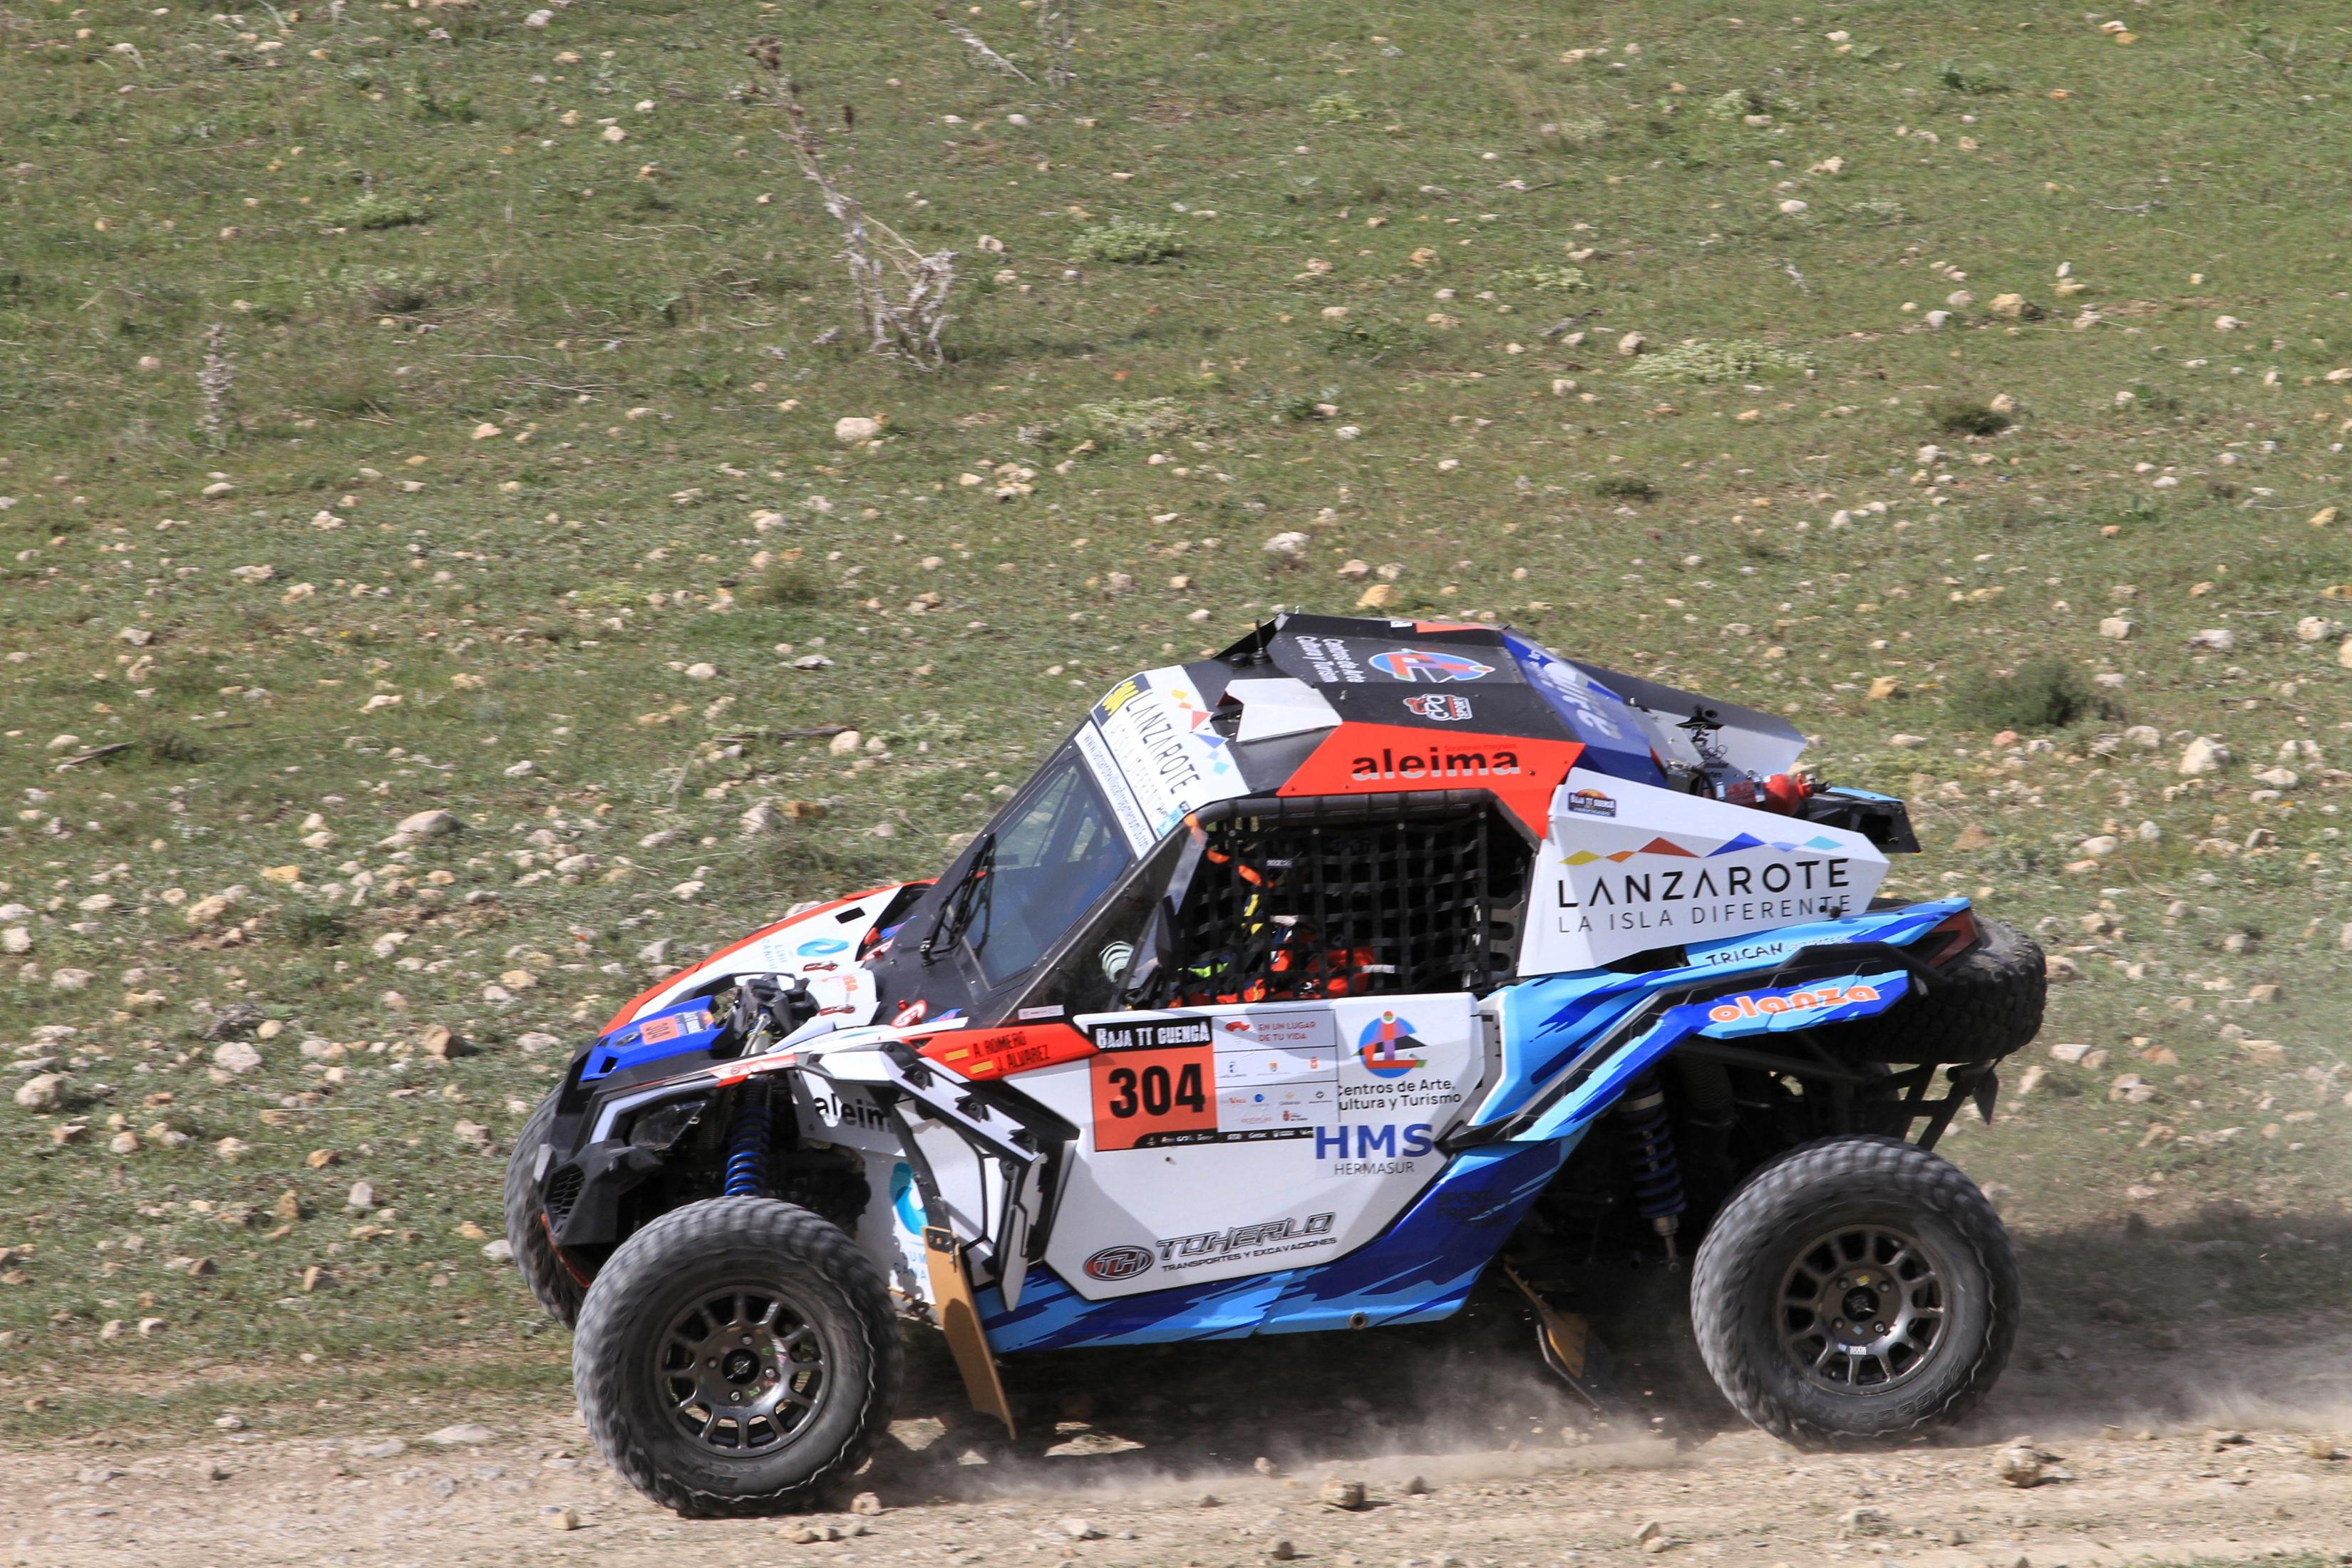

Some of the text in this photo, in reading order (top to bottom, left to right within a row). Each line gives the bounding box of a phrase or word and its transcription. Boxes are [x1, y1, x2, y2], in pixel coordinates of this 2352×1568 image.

[1322, 639, 1351, 661] Centros
[1336, 660, 1359, 669] de
[1125, 691, 1201, 795] LANZAROTE
[1352, 747, 1521, 780] aleima
[1558, 857, 1850, 909] LANZAROTE
[1559, 894, 1852, 933] LA ISLA DIFERENTE
[1706, 942, 1783, 966] TRICAN
[1708, 985, 1880, 1022] olanza
[1095, 1028, 1133, 1048] BAJA
[1136, 1027, 1154, 1046] TT
[1259, 1033, 1270, 1042] DE
[1272, 1022, 1284, 1031] UN
[1286, 1021, 1316, 1030] LUGAR
[984, 1031, 1027, 1056] ROMERO
[1108, 1063, 1206, 1118] 304
[1398, 1080, 1415, 1093] de
[1420, 1078, 1456, 1091] Arte,
[1339, 1092, 1462, 1112] ultura y Turismo
[1316, 1123, 1433, 1160] HMS
[1334, 1161, 1415, 1175] HERMASUR
[1156, 1212, 1336, 1261] TOHERLO
[1162, 1237, 1337, 1272] TRANSPORTES Y EXCAVACIONES
